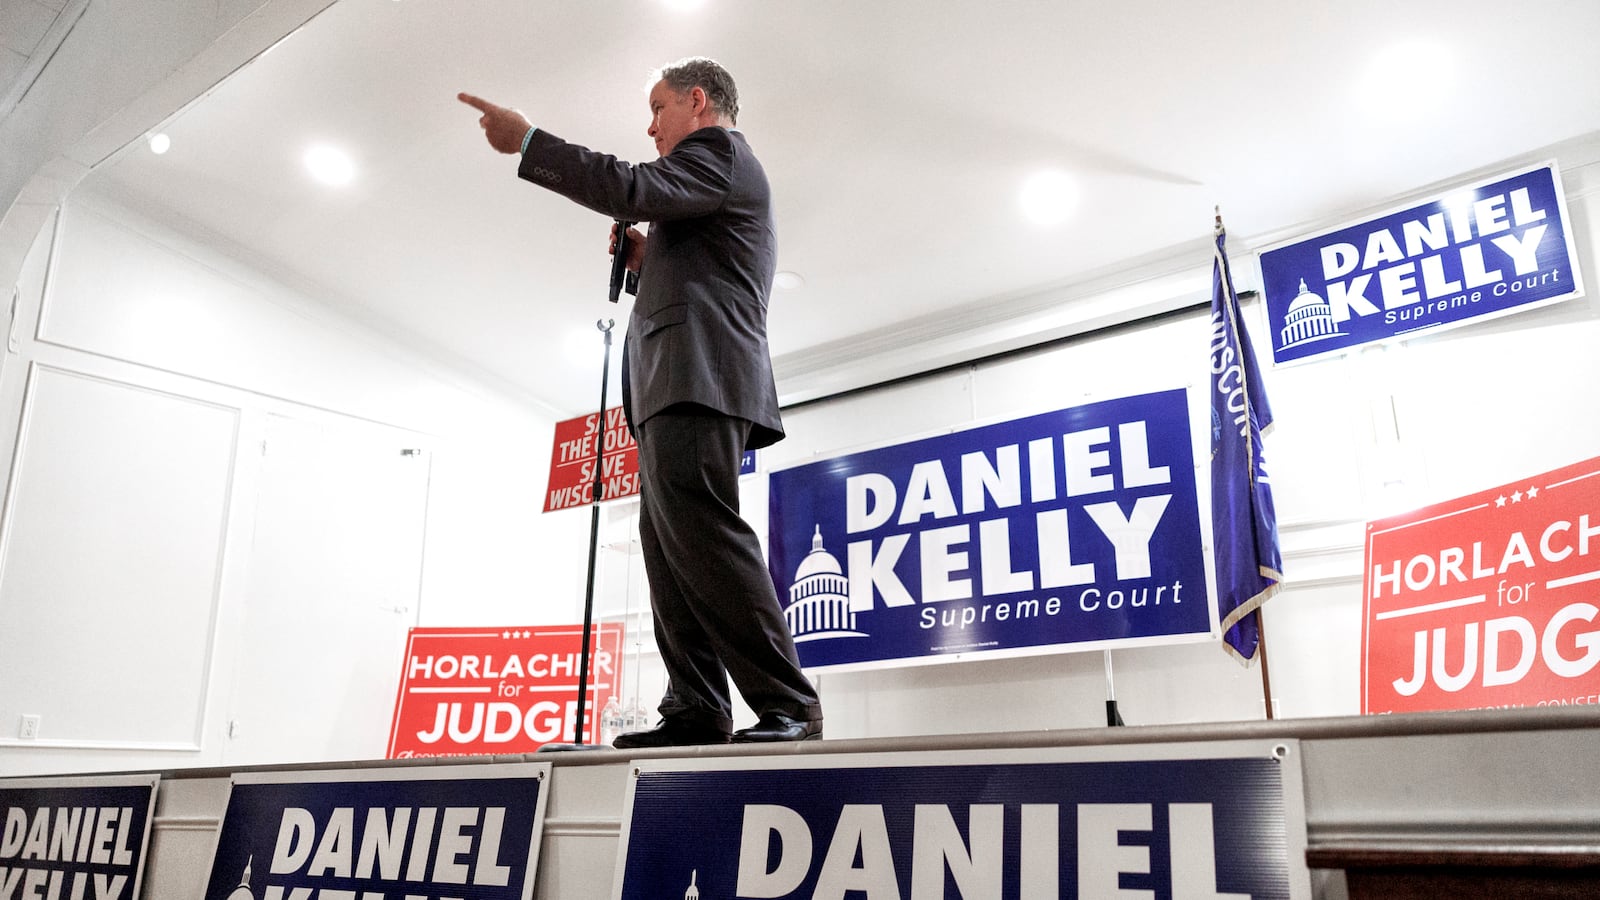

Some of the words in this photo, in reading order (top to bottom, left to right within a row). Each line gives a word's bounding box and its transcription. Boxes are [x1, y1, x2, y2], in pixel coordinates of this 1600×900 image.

[1320, 187, 1547, 281] DANIEL
[1326, 224, 1548, 324] KELLY
[1384, 291, 1481, 324] Supreme
[1493, 268, 1560, 297] Court
[560, 436, 591, 463] THE
[846, 420, 1171, 534] DANIEL
[550, 471, 641, 510] WISCNSI
[847, 494, 1173, 613] KELLY
[919, 597, 1061, 630] Supreme
[1079, 580, 1183, 613] Court
[1497, 579, 1535, 607] for
[409, 651, 613, 679] HORLACHER
[1392, 602, 1600, 697] JUDG
[498, 680, 523, 697] for
[416, 700, 593, 743] JUDGE
[0, 806, 133, 866] DANIEL
[269, 807, 512, 887] DANIEL
[736, 802, 1252, 900] DANIEL
